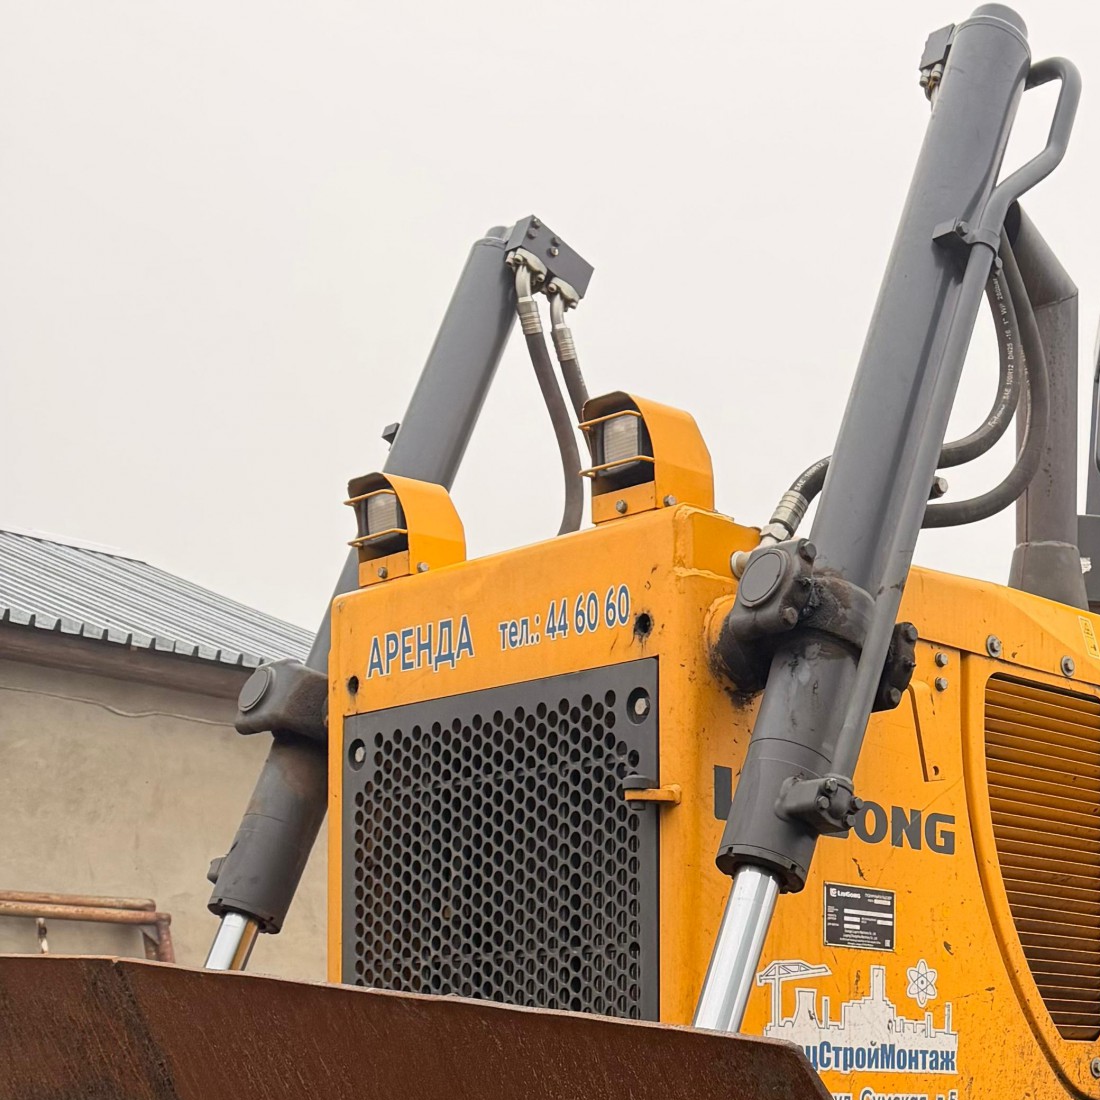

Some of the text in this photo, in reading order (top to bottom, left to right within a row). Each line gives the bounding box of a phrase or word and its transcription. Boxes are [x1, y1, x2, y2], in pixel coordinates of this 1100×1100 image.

[367, 614, 474, 679] АРЕНДА
[499, 583, 630, 651] тел.: 44 60 60
[804, 1040, 956, 1072] цСтройМонтаж
